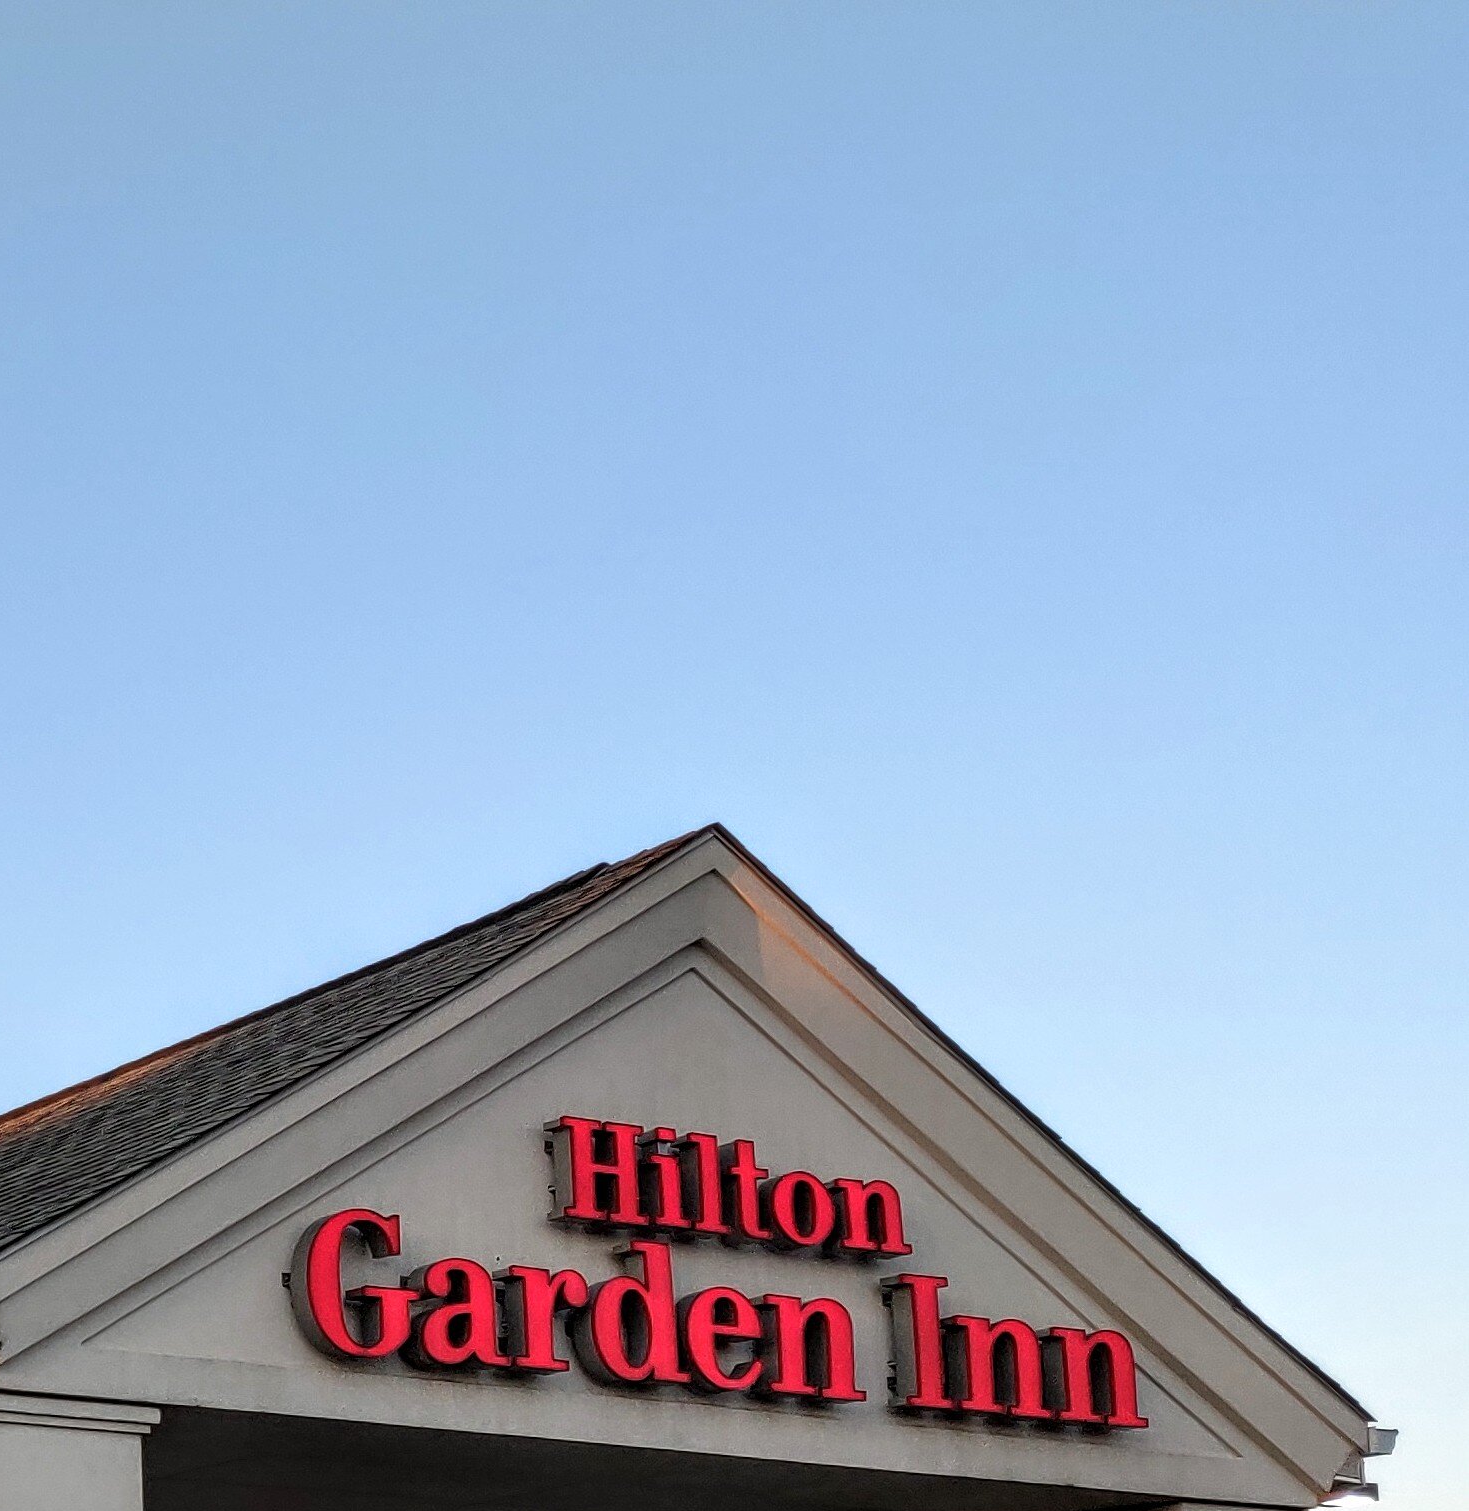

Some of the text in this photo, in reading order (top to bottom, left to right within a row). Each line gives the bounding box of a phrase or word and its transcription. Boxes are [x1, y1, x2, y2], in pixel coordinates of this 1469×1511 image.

[553, 1115, 913, 1257] Hilton
[295, 1208, 1149, 1430] Garden Inn
